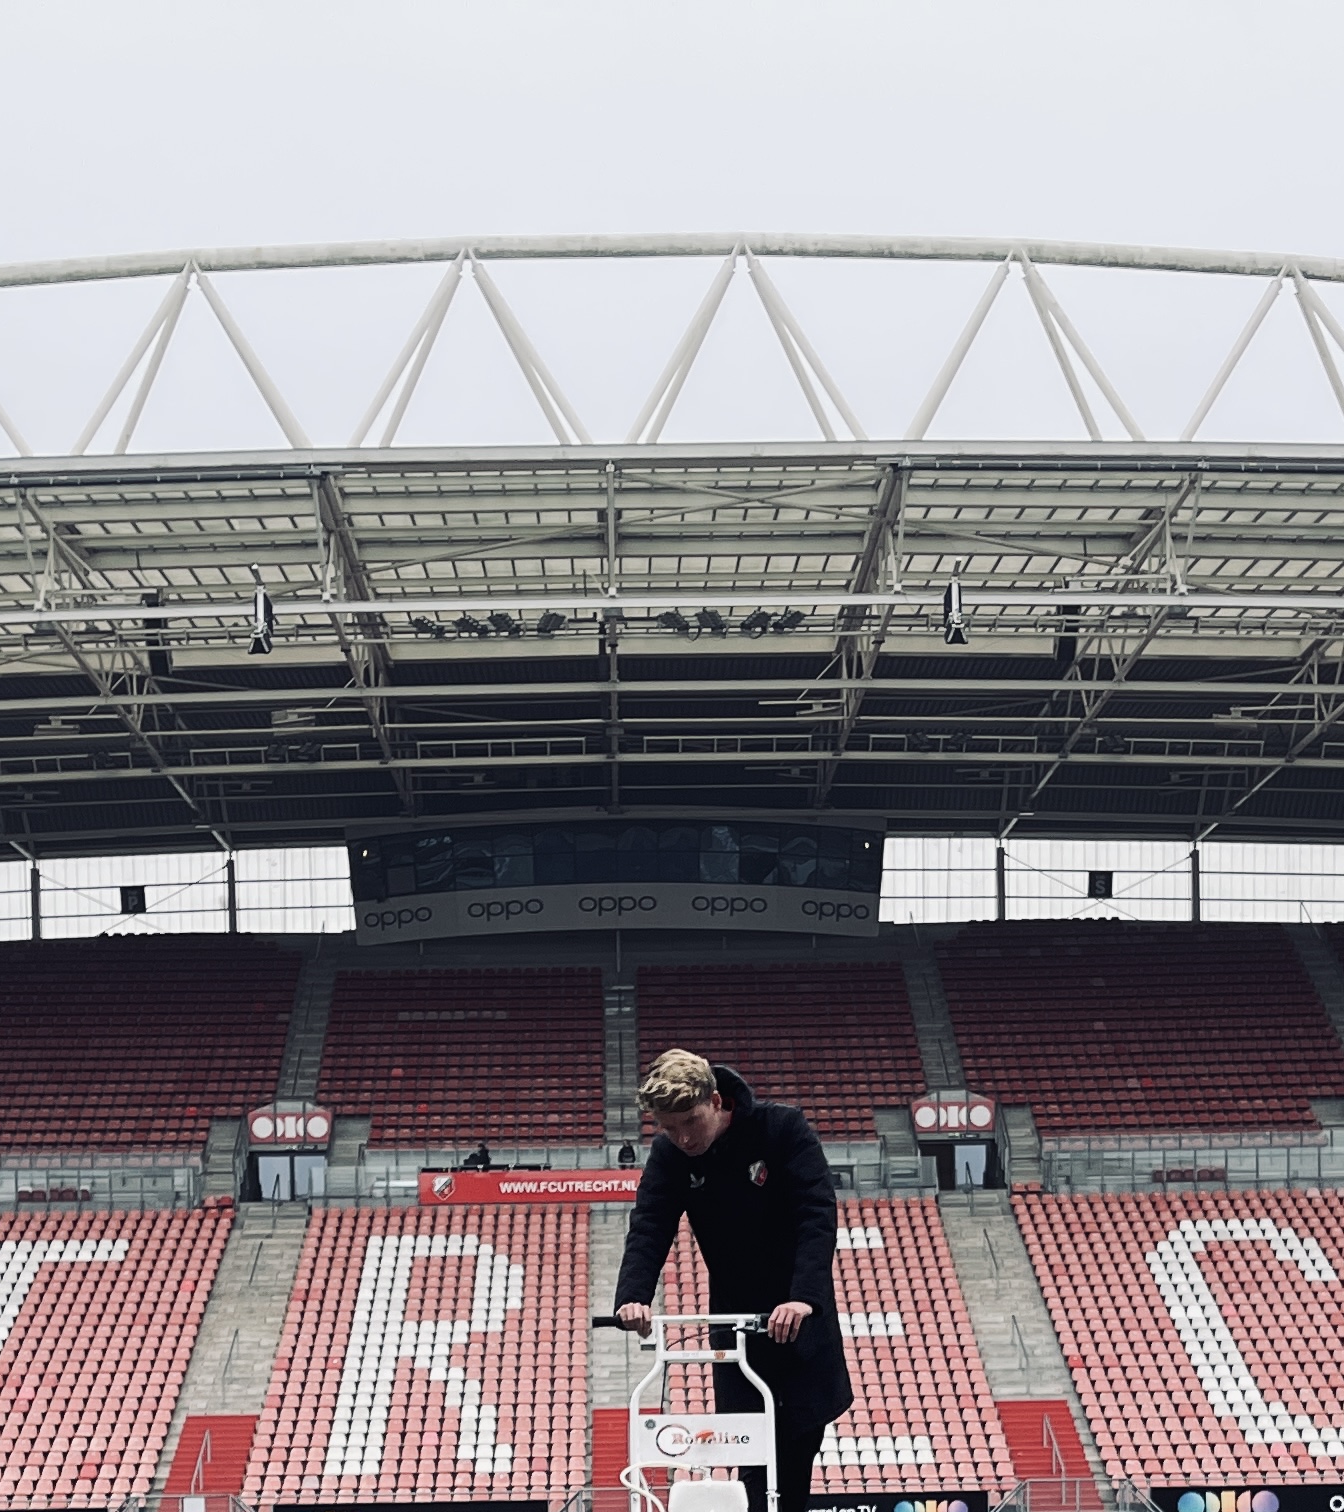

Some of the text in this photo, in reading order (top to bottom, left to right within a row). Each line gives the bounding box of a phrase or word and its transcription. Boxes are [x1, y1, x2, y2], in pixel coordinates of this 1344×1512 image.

[363, 904, 432, 931] oppo
[467, 897, 544, 922] oppo
[578, 894, 657, 917] oppo
[691, 895, 768, 918] oppo
[801, 898, 870, 923] oppo
[498, 1179, 638, 1195] WWW.FCUTRECHT.NL
